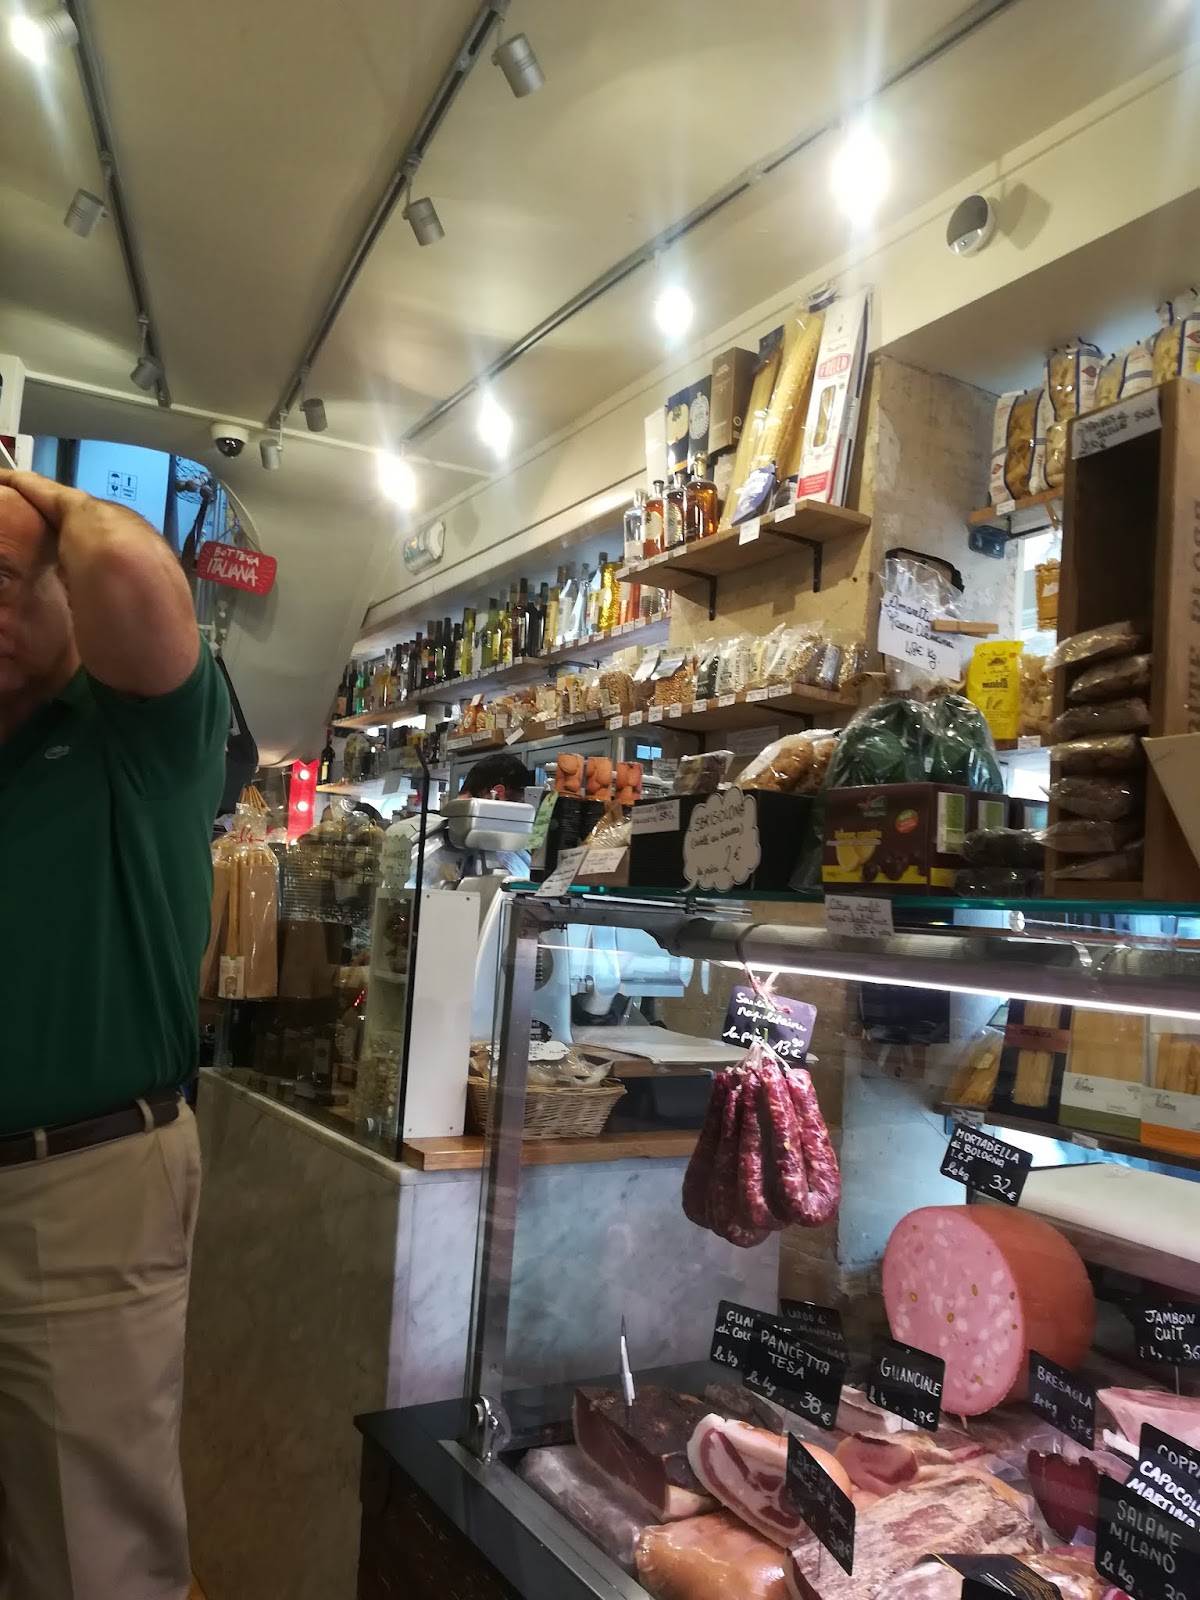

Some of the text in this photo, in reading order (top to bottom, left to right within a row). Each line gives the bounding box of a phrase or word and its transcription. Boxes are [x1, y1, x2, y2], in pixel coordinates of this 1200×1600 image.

[206, 558, 258, 587] ITALIANA
[213, 546, 259, 567] BOTTEGA
[956, 1128, 1020, 1165] MORTADELLA
[963, 1143, 1006, 1168] BOLOGNA
[1144, 1309, 1196, 1325] JAMBON
[760, 1329, 830, 1376] PANCETTA
[768, 1351, 805, 1380] TESA
[1037, 1365, 1093, 1411] BRESAOLA
[1116, 1499, 1183, 1555] SALAME
[1110, 1521, 1176, 1574] MILANO
